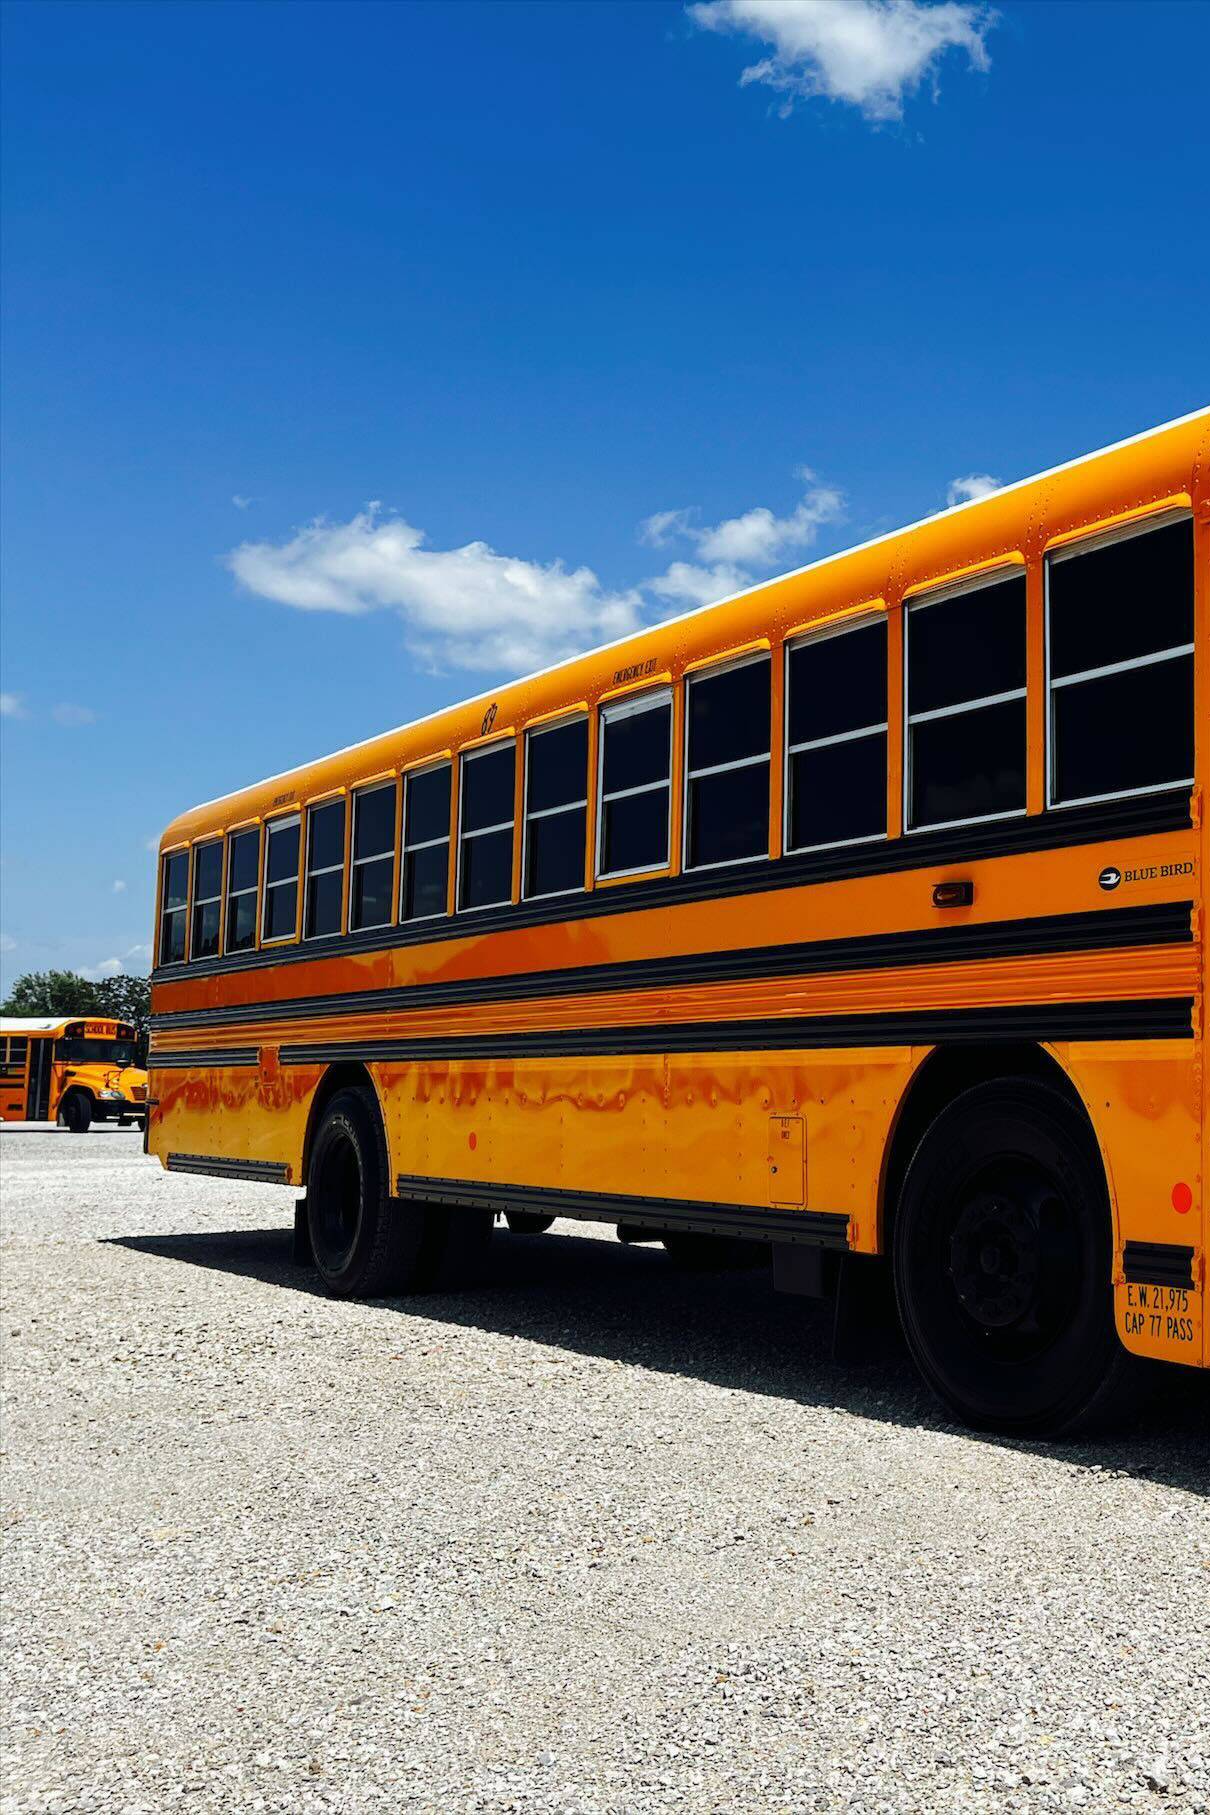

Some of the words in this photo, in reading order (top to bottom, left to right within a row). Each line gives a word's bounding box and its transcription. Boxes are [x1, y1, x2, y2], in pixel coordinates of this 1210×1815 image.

[1124, 867, 1157, 882] BLUE
[1160, 862, 1193, 877] BIRD
[1153, 1287, 1189, 1312] 21,975
[1125, 1311, 1144, 1335] CAP
[1149, 1314, 1162, 1338] 77
[1167, 1316, 1193, 1341] PASS
